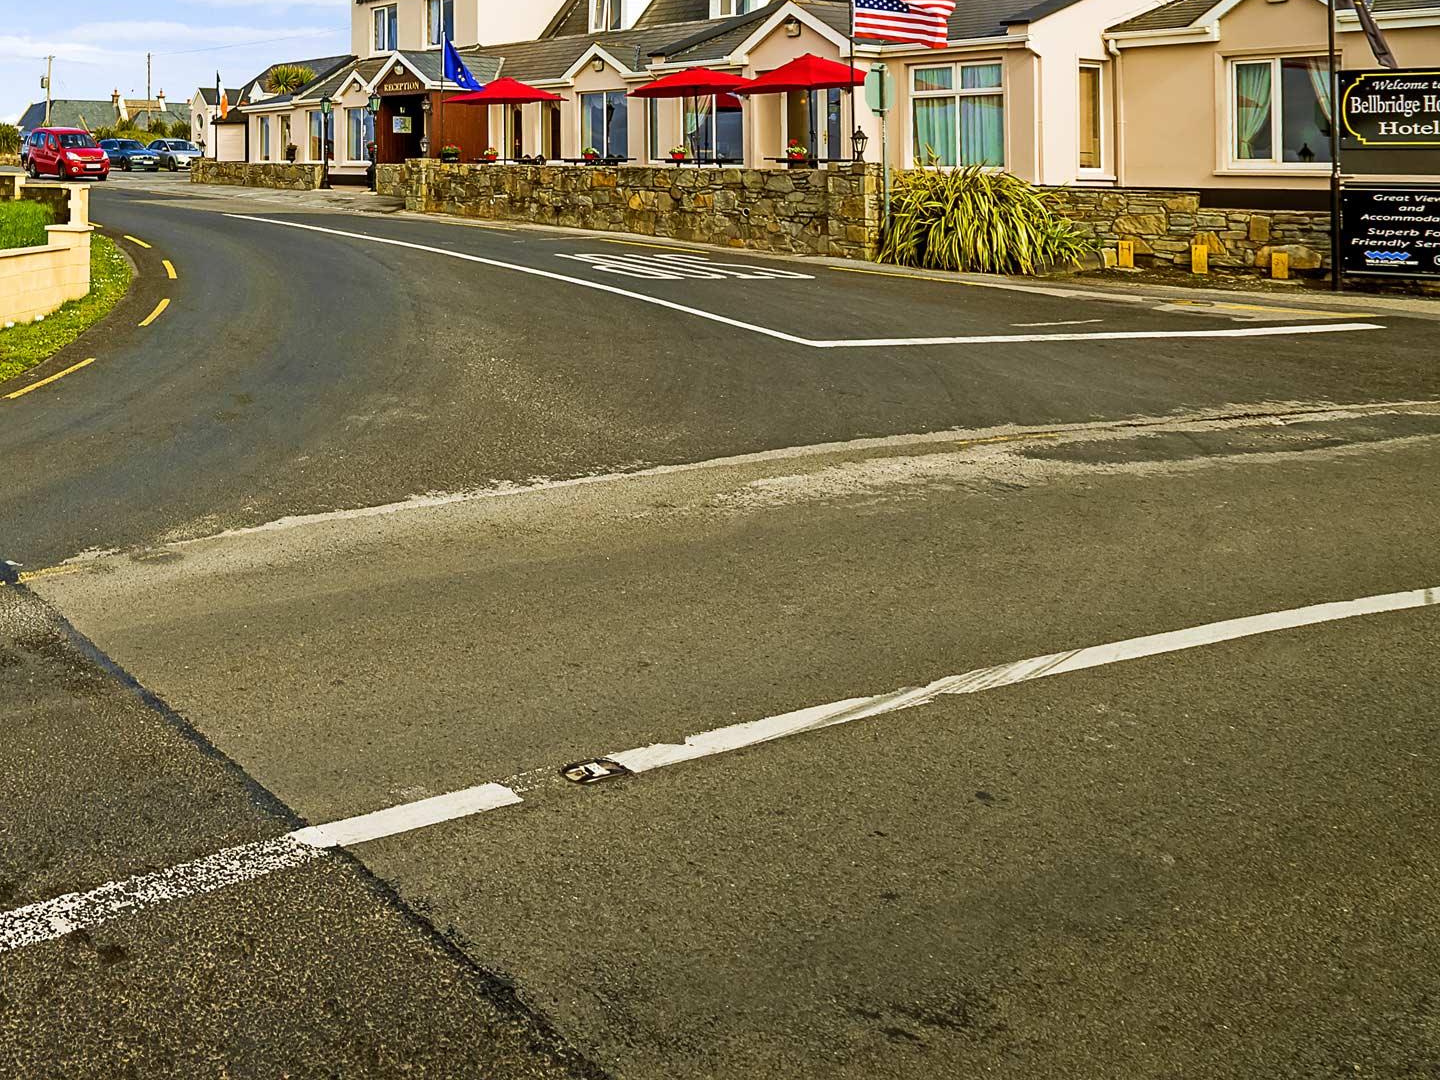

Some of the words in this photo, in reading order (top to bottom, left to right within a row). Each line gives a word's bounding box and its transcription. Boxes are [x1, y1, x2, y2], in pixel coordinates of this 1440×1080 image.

[383, 81, 420, 92] RECEPTION
[1372, 79, 1429, 90] Welcome
[1350, 94, 1421, 117] Bellbridge
[1378, 120, 1440, 135] Hotel
[1360, 213, 1440, 222] Accommoda
[1367, 227, 1420, 237] Superb
[1351, 237, 1410, 248] Friendly
[553, 253, 816, 280] STOP
